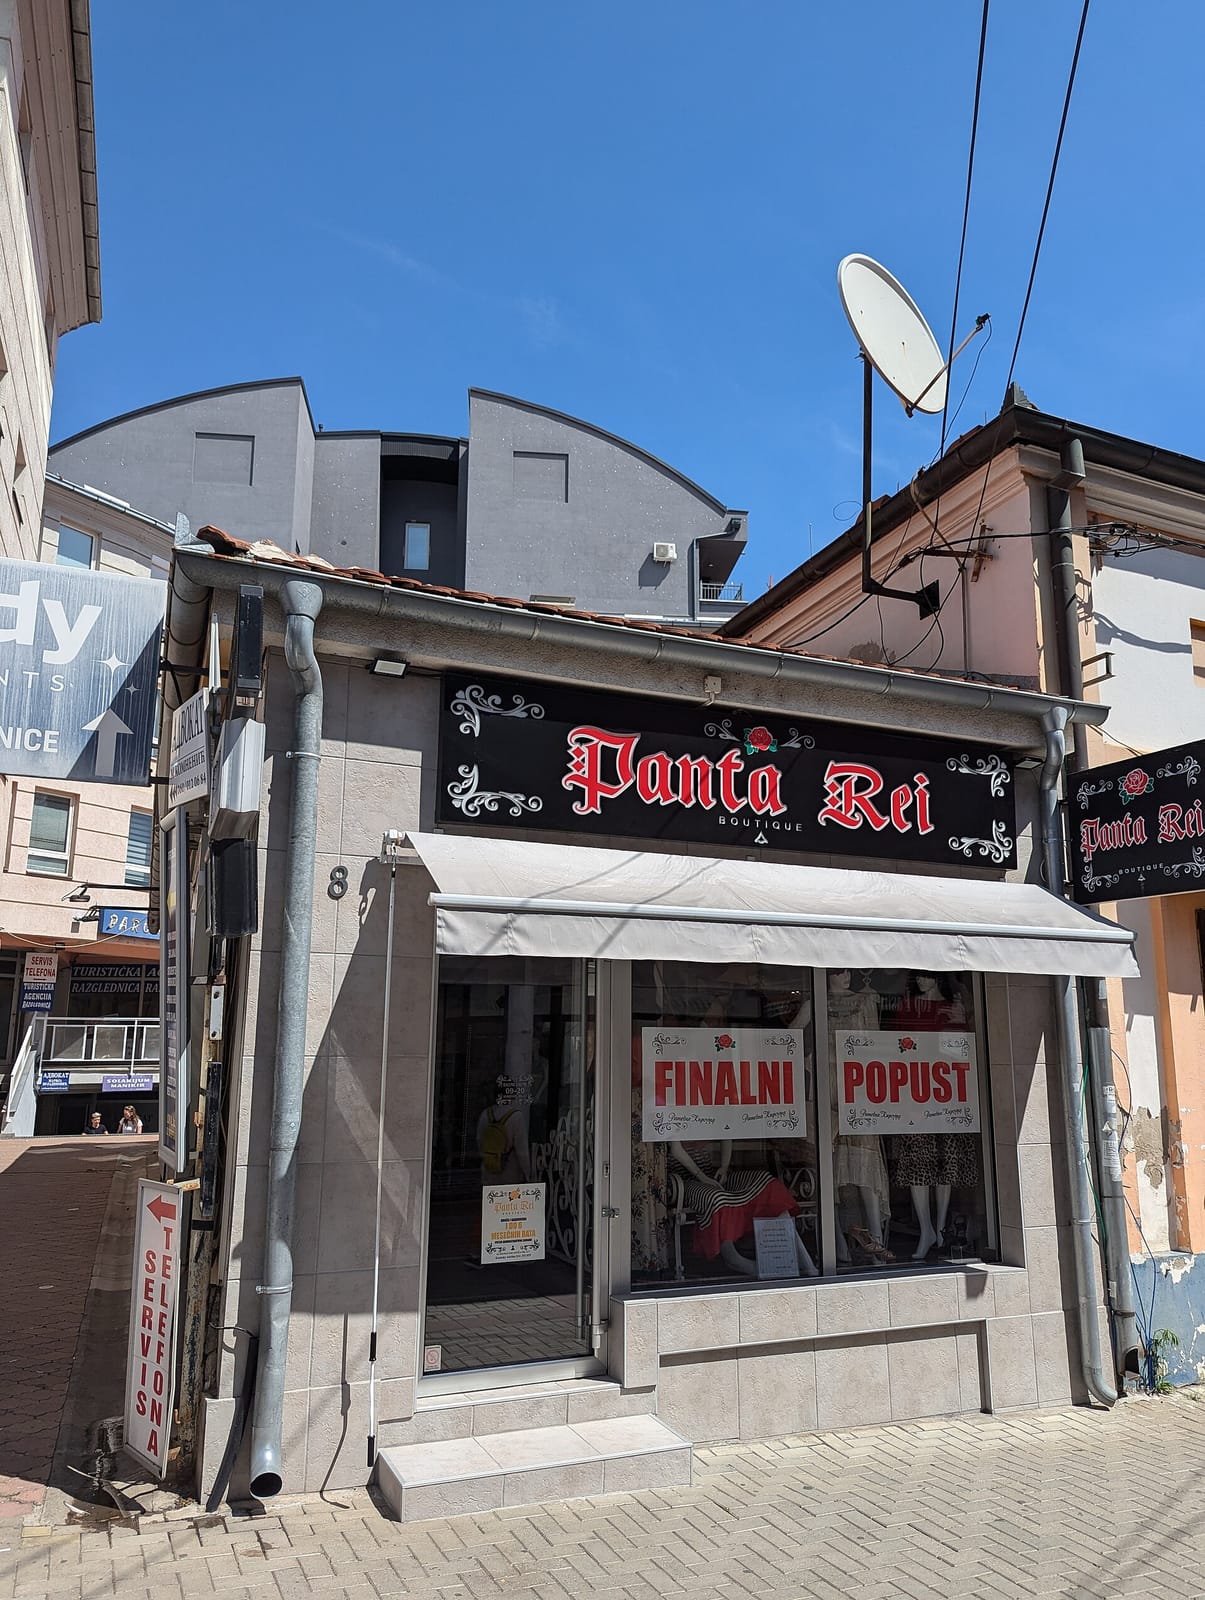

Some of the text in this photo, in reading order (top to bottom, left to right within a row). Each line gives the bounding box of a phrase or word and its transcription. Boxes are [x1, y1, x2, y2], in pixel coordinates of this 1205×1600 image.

[561, 724, 935, 834] Panta Rei
[718, 815, 804, 832] BOUTIQUE
[1080, 799, 1205, 863] Panta Rei
[327, 865, 348, 901] 8
[1118, 862, 1164, 875] BOUTIQUE
[25, 967, 55, 977] TELEFONA
[31, 956, 53, 965] SERVIS
[73, 965, 141, 977] TURISTIČKA
[72, 982, 140, 993] RAZGLEDNICA
[654, 1060, 794, 1107] FINALNI
[843, 1060, 971, 1104] POPUST
[135, 1250, 158, 1417] SERVIS
[147, 1227, 173, 1458] TELEFONA
